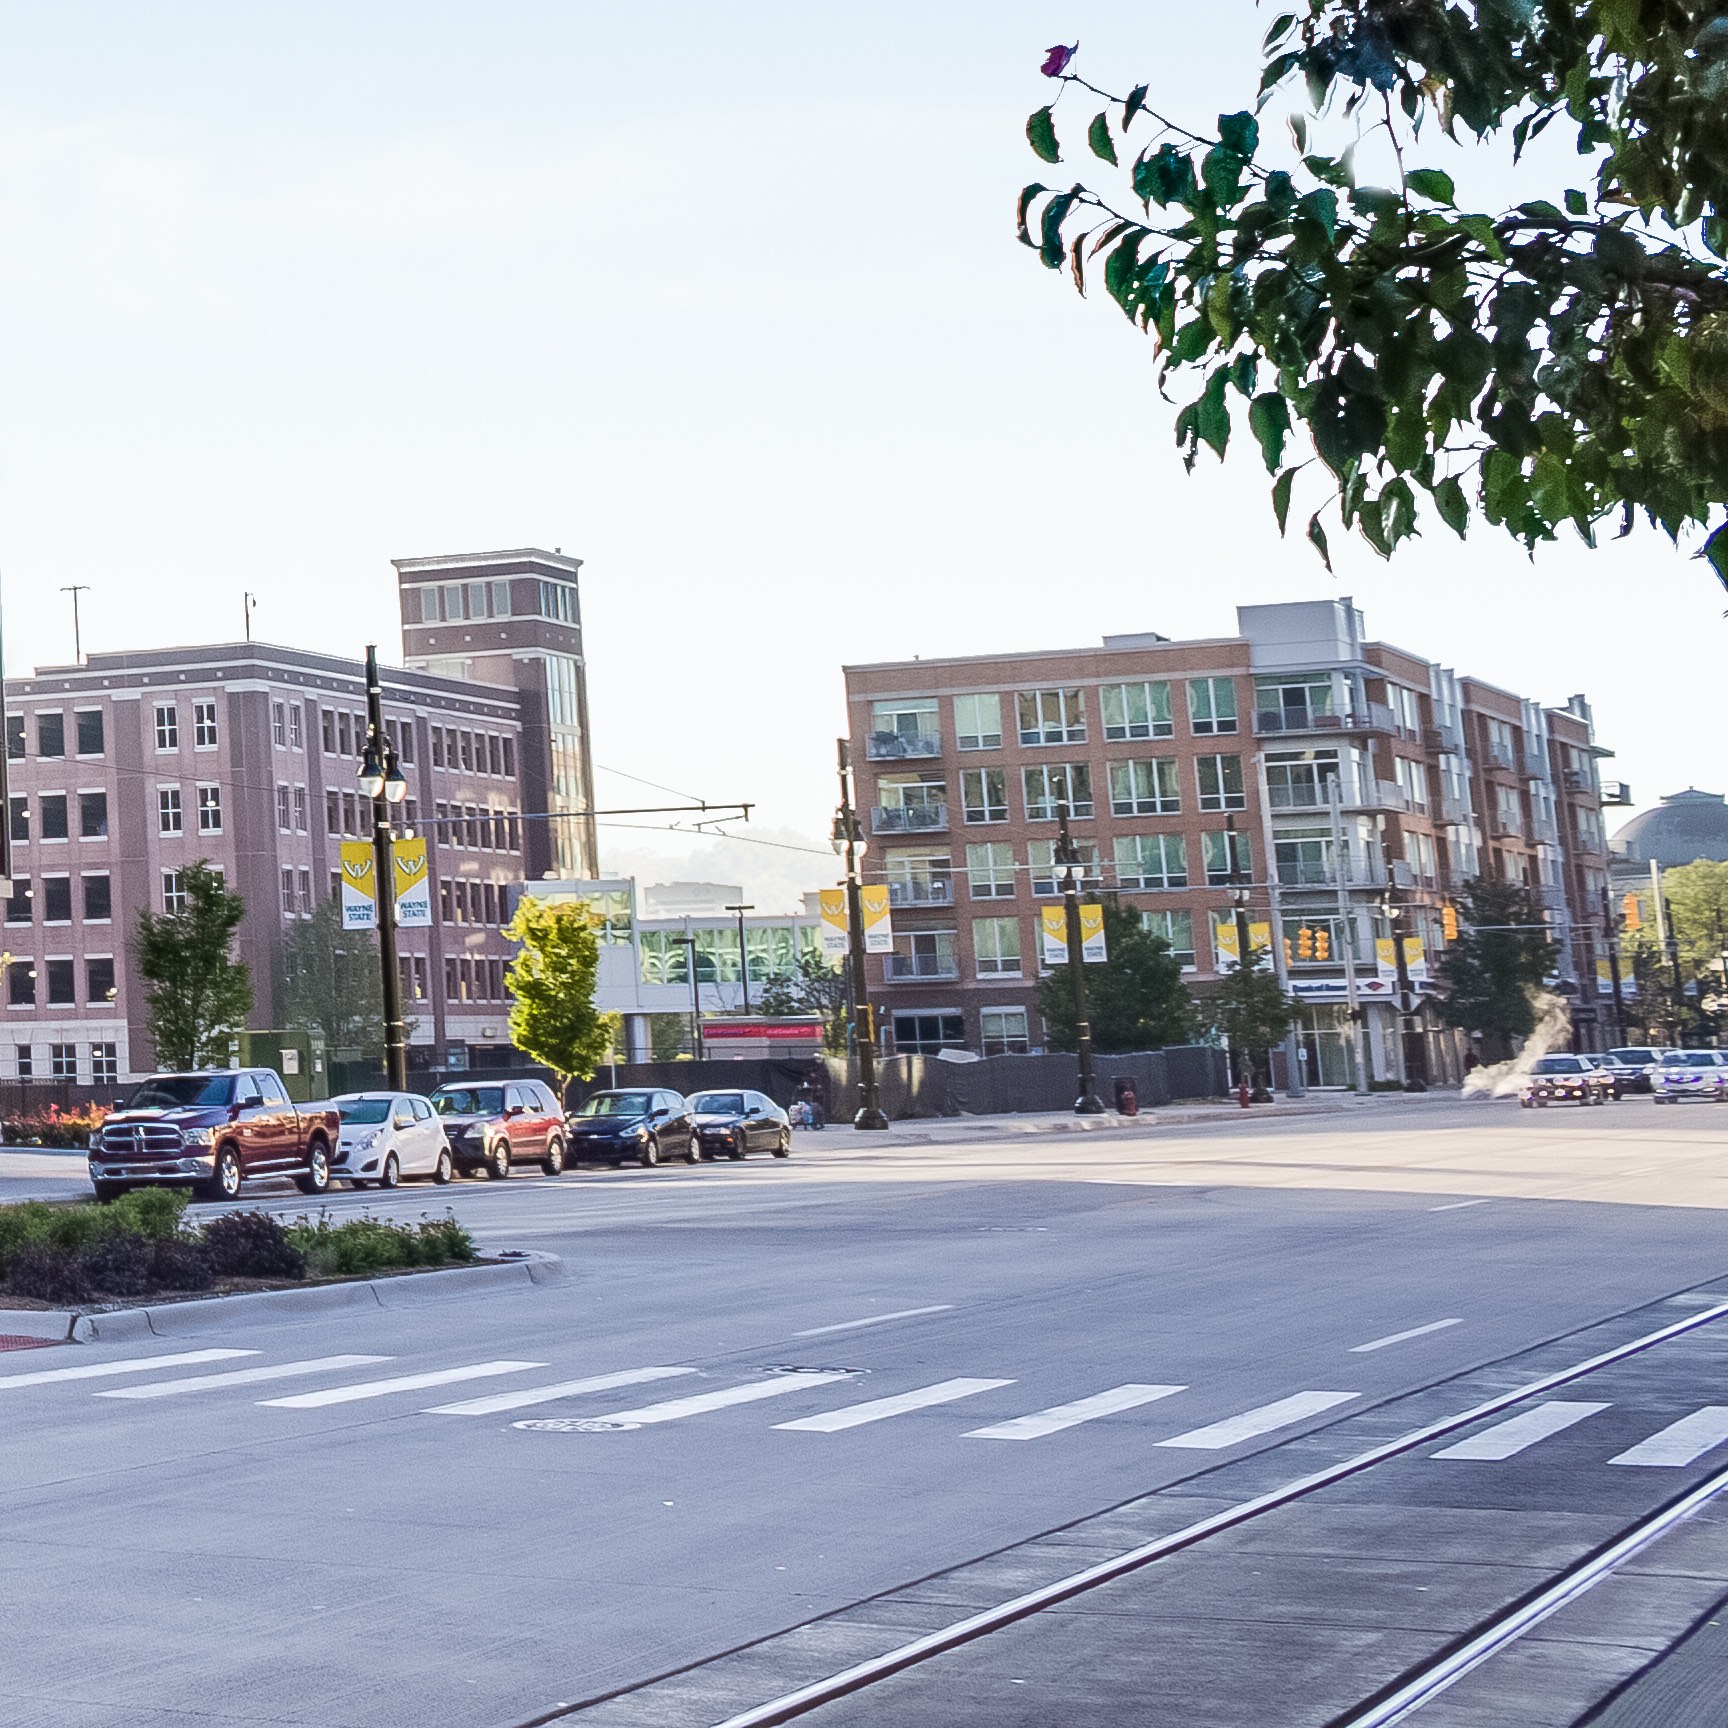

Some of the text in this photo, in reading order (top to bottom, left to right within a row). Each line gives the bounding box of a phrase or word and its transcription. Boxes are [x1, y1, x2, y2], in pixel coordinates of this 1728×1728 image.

[345, 904, 373, 913] WAYNE
[400, 900, 428, 910] WAYNE
[348, 913, 372, 921] STATE
[403, 910, 426, 918] STATE
